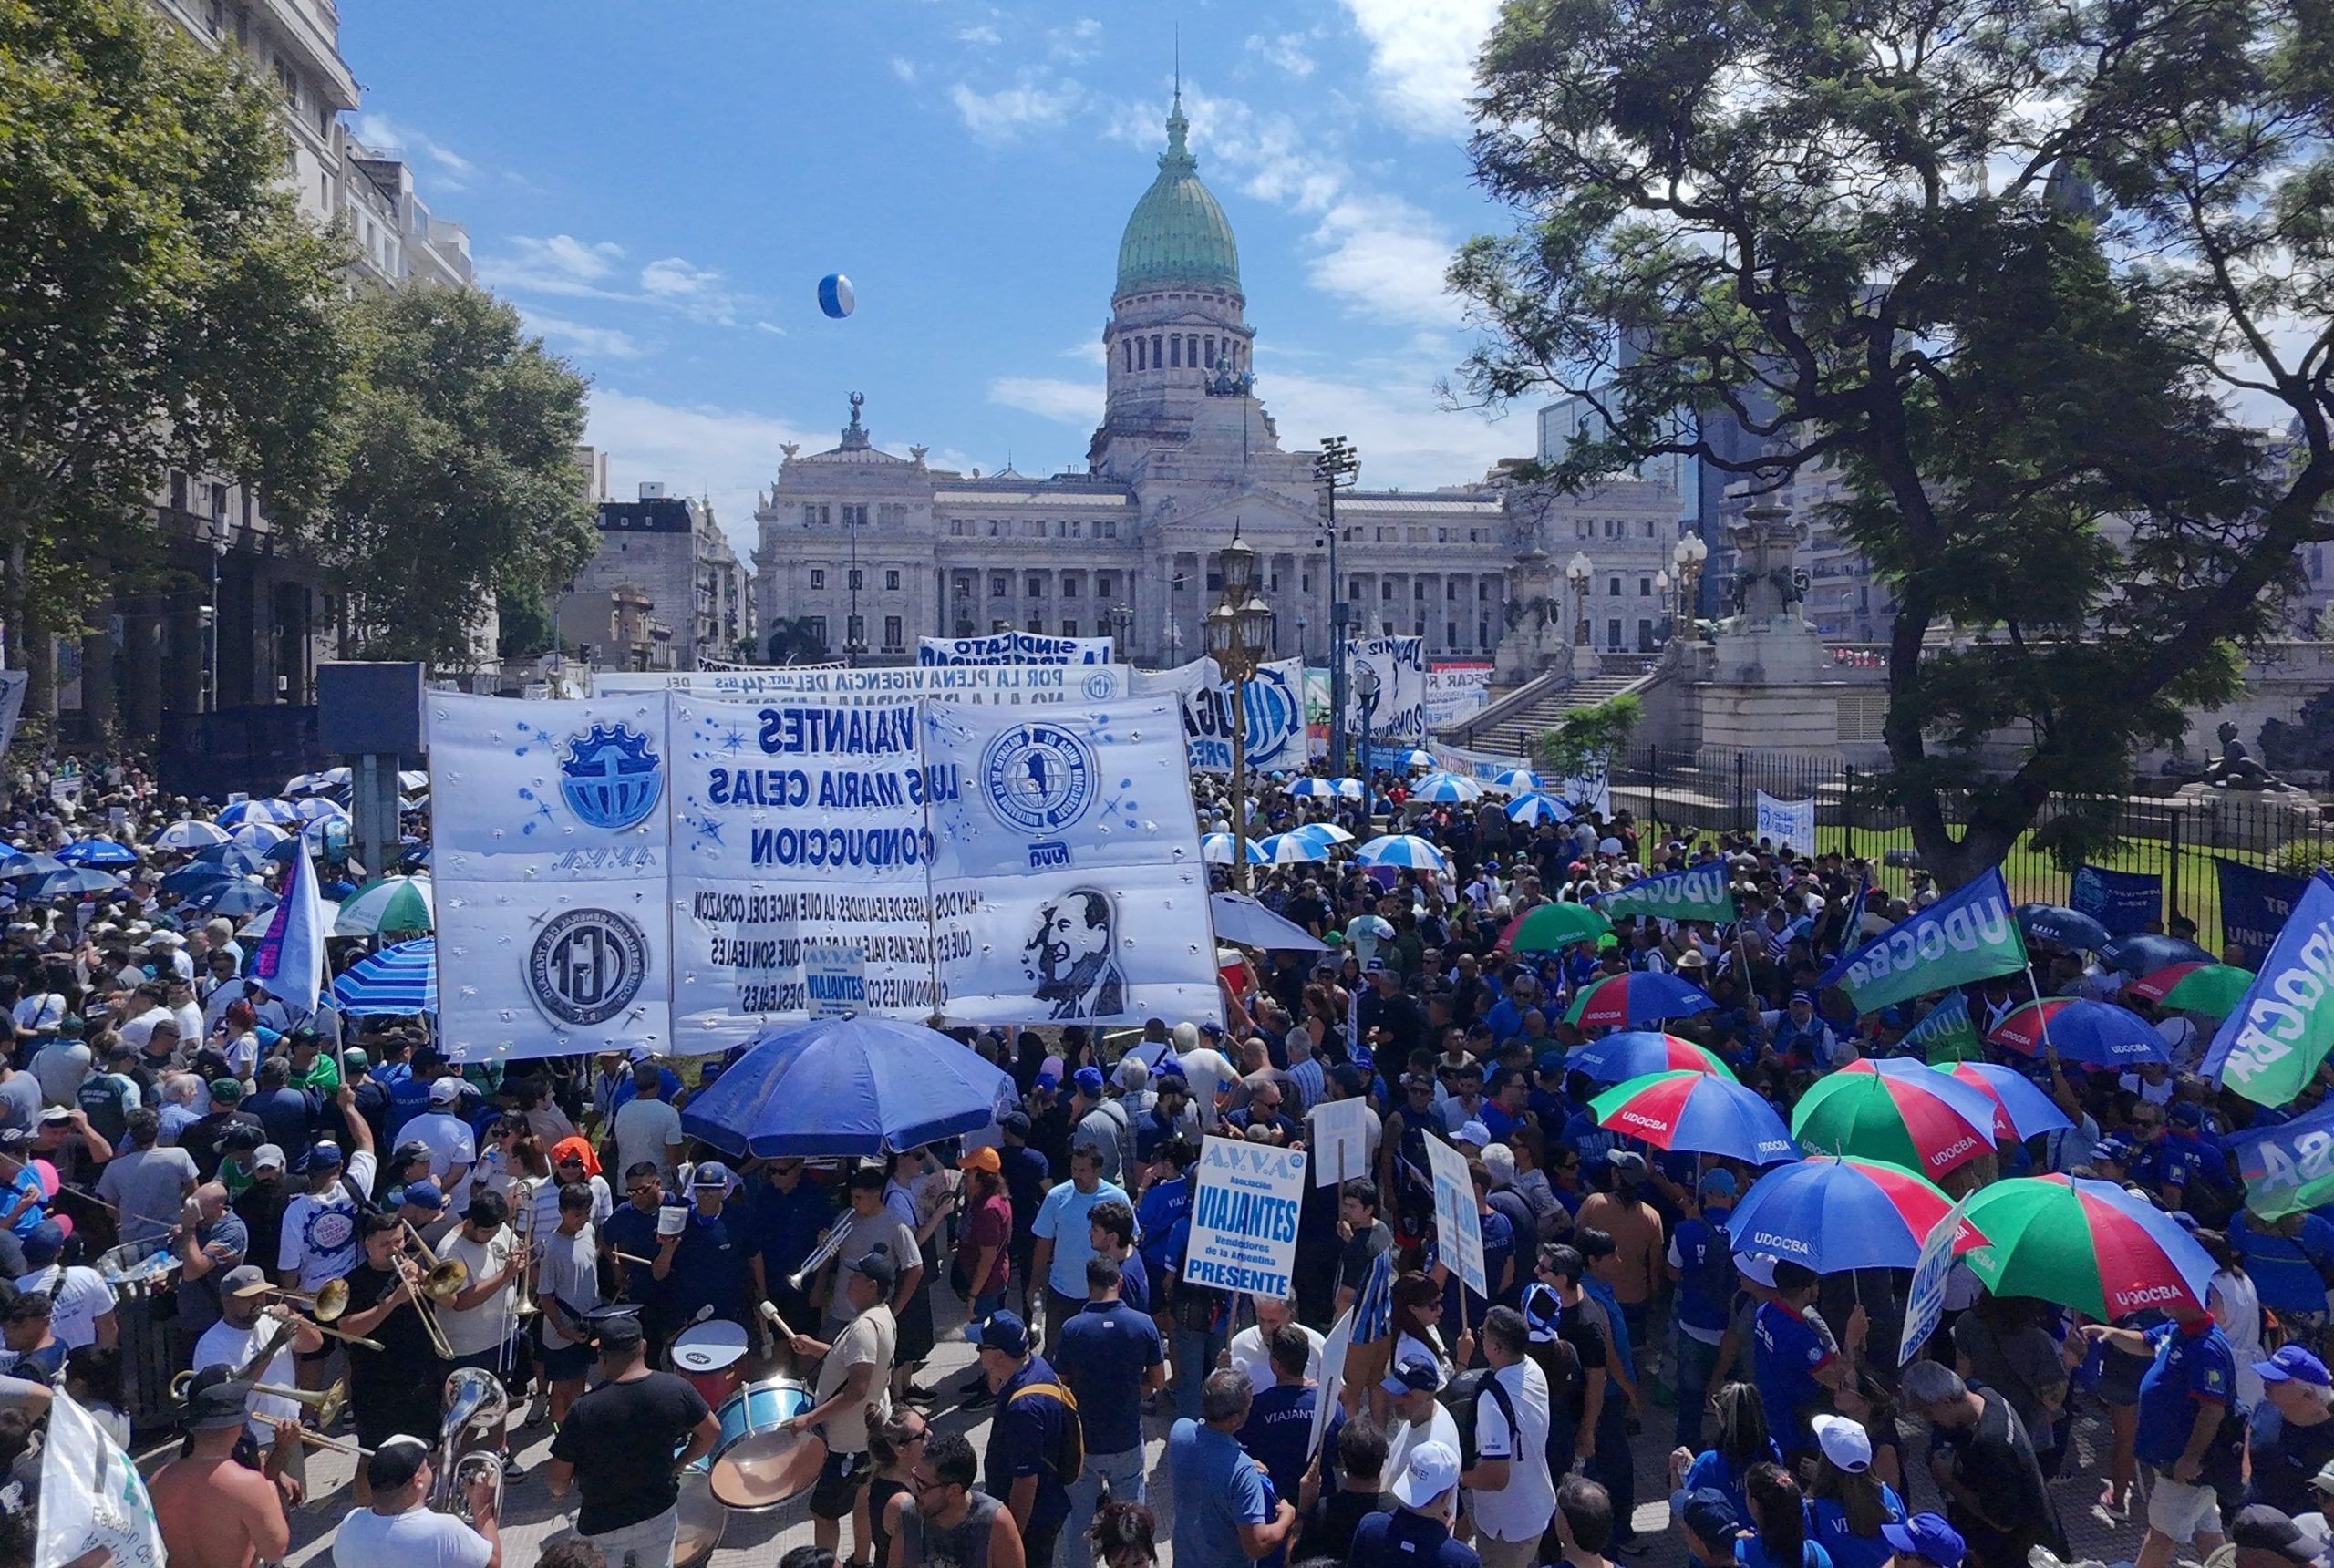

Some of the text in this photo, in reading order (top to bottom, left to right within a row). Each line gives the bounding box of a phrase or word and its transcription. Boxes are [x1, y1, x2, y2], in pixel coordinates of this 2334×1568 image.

[807, 975, 865, 1001] VIAJANTES
[1587, 1010, 1622, 1020] UDOCBA
[2111, 1043, 2152, 1055] UDOCBA
[1622, 1110, 1668, 1132] UDOCBA
[1758, 1140, 1792, 1153] UDOCBA
[1931, 1135, 1978, 1167] UDOCBA
[1197, 1184, 1298, 1243] VIAJANTES
[1215, 1234, 1271, 1253] Vendedores
[1754, 1231, 1810, 1256] UDOCBA
[1205, 1246, 1276, 1267] de la Argentina
[1187, 1258, 1289, 1295] PRESENTE
[1265, 1408, 1316, 1424] VIAJANT
